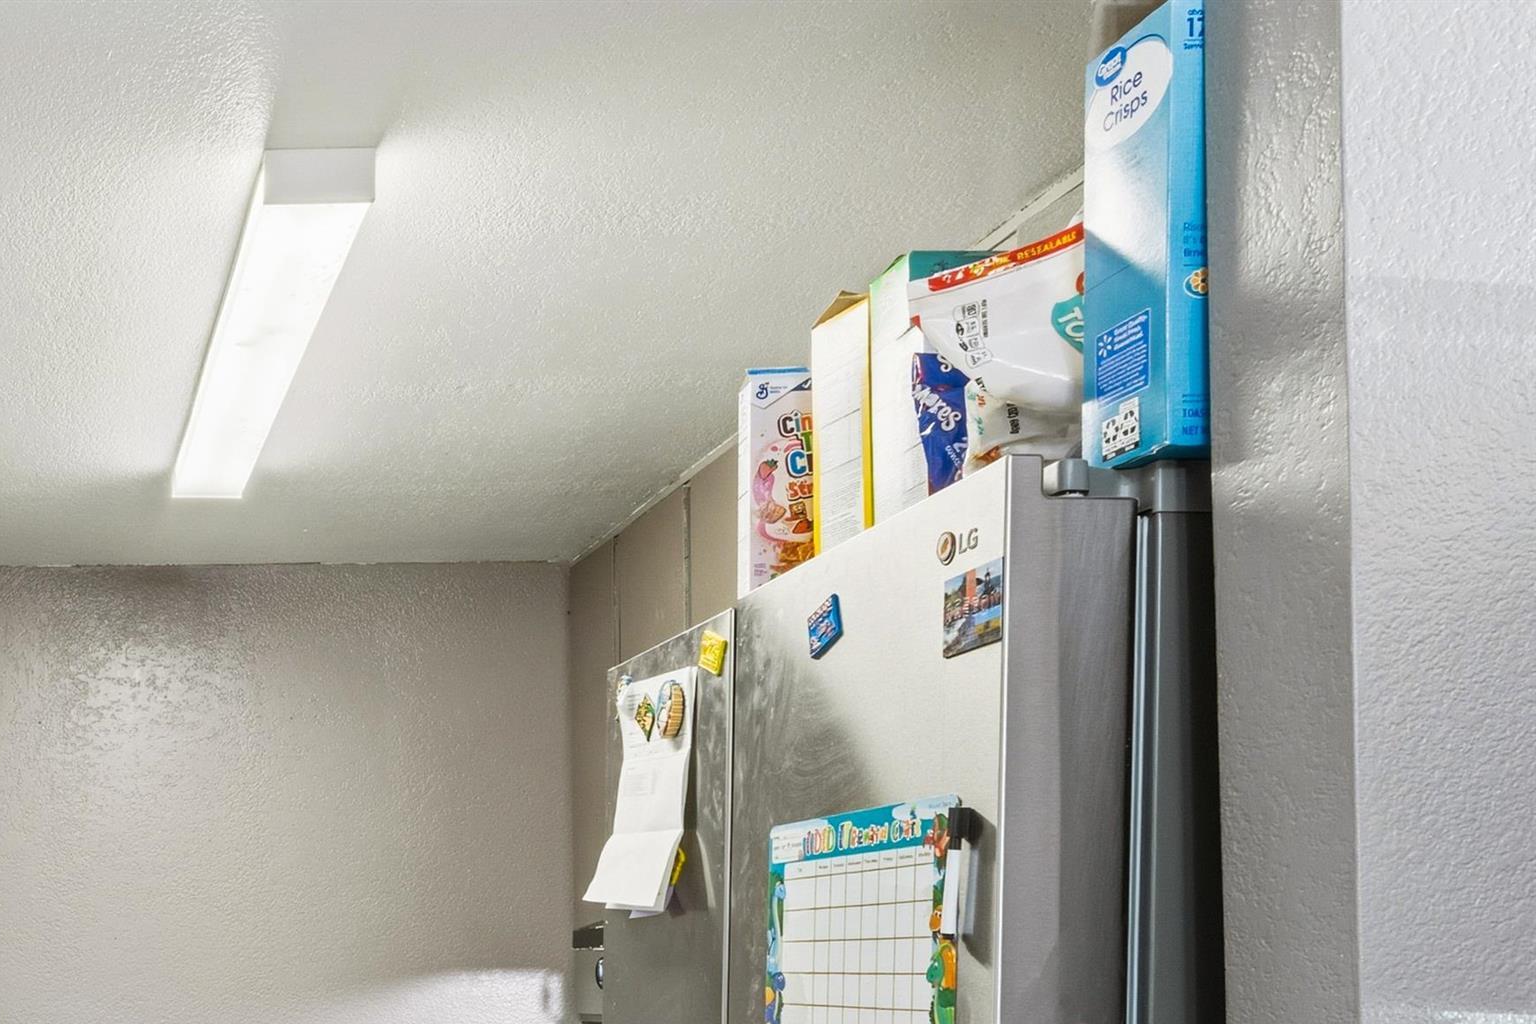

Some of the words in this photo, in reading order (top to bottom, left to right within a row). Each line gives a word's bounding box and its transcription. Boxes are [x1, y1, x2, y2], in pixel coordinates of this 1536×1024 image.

[1110, 71, 1143, 105] Rice
[1103, 90, 1148, 132] Crisps
[1016, 231, 1077, 260] RESEALABLE
[959, 528, 978, 554] LG
